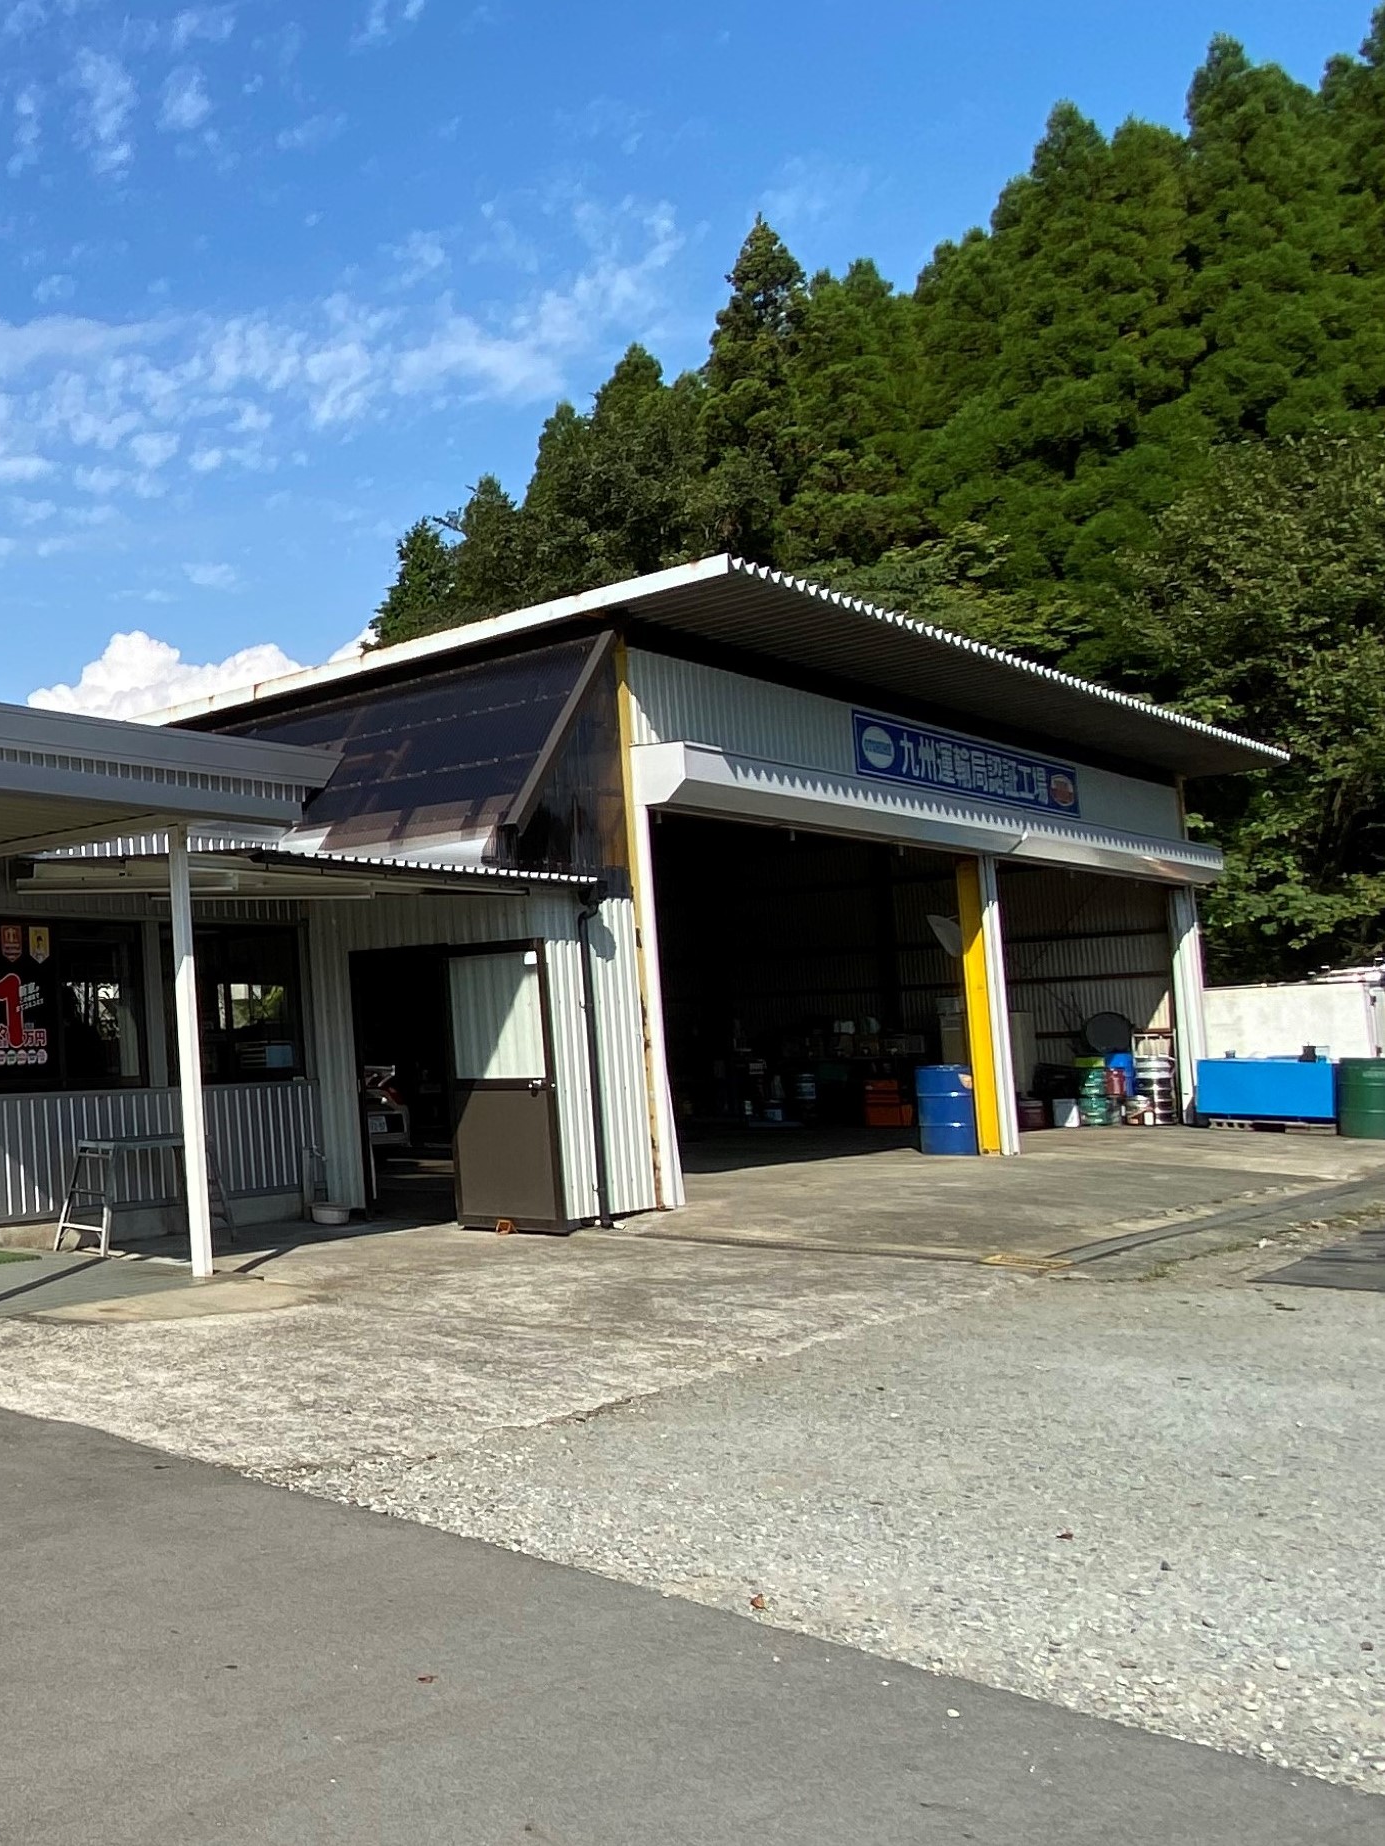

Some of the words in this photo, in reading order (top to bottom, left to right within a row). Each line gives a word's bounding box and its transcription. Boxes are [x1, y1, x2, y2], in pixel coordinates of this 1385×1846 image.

[900, 732, 1049, 805] 九州運輸局認証工場
